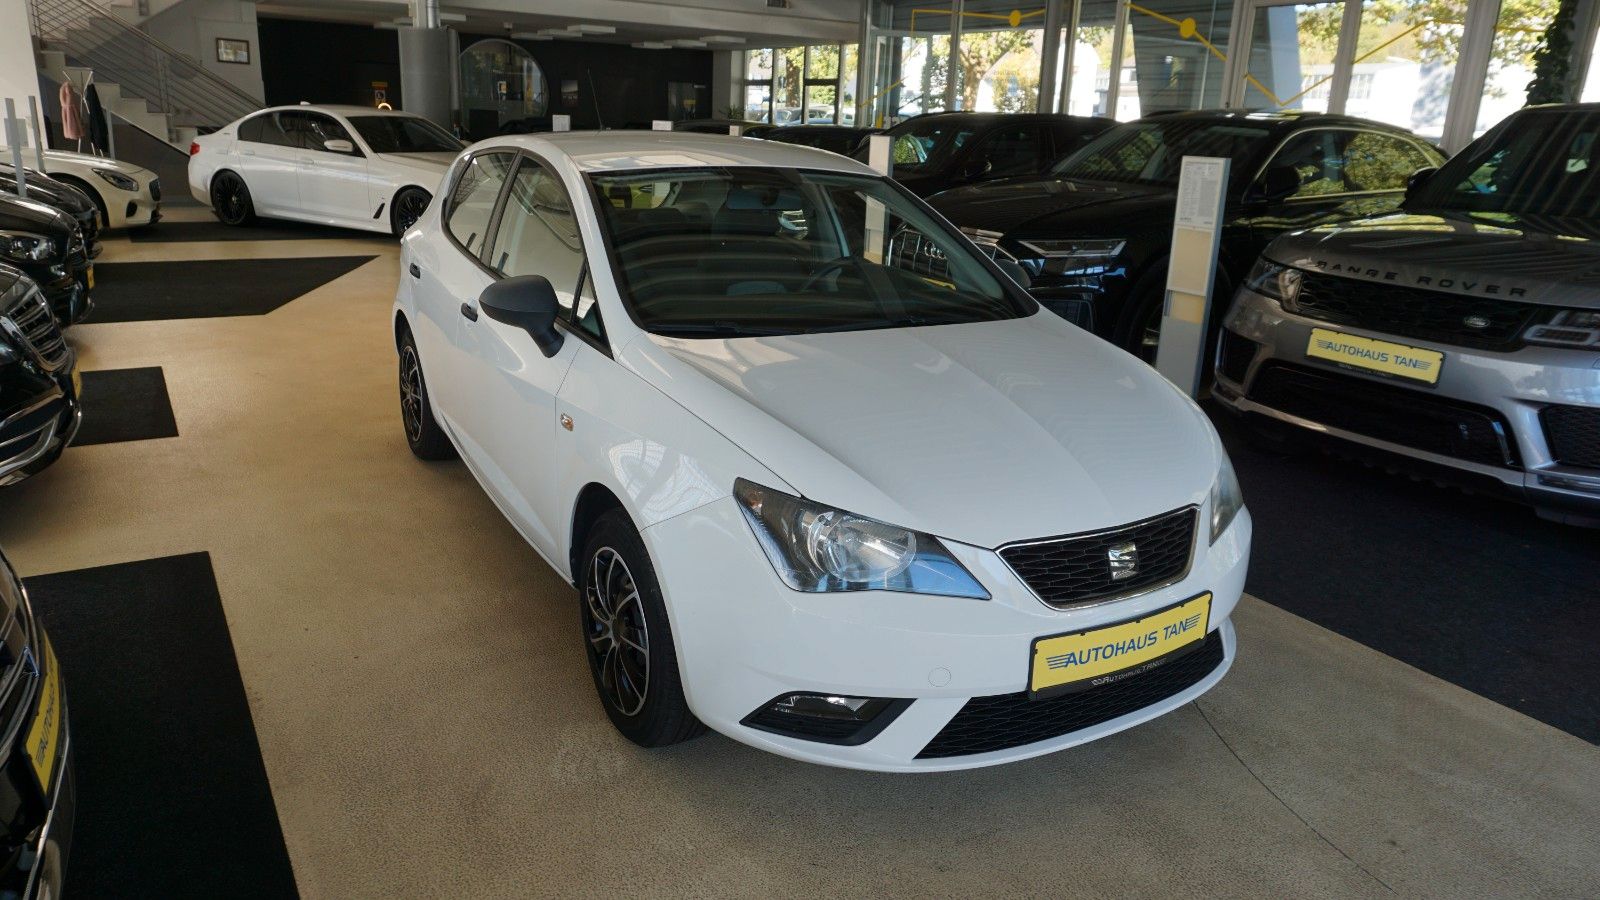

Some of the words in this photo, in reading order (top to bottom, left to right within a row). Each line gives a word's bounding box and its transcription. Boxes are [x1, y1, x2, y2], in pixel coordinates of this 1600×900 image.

[1315, 261, 1398, 281] RANGE
[1416, 275, 1528, 297] ROVER
[1326, 342, 1388, 362] AUTOHAUS
[1393, 355, 1418, 369] TAN
[1064, 631, 1158, 668] AUTOHAUS
[1164, 618, 1189, 640] TAN
